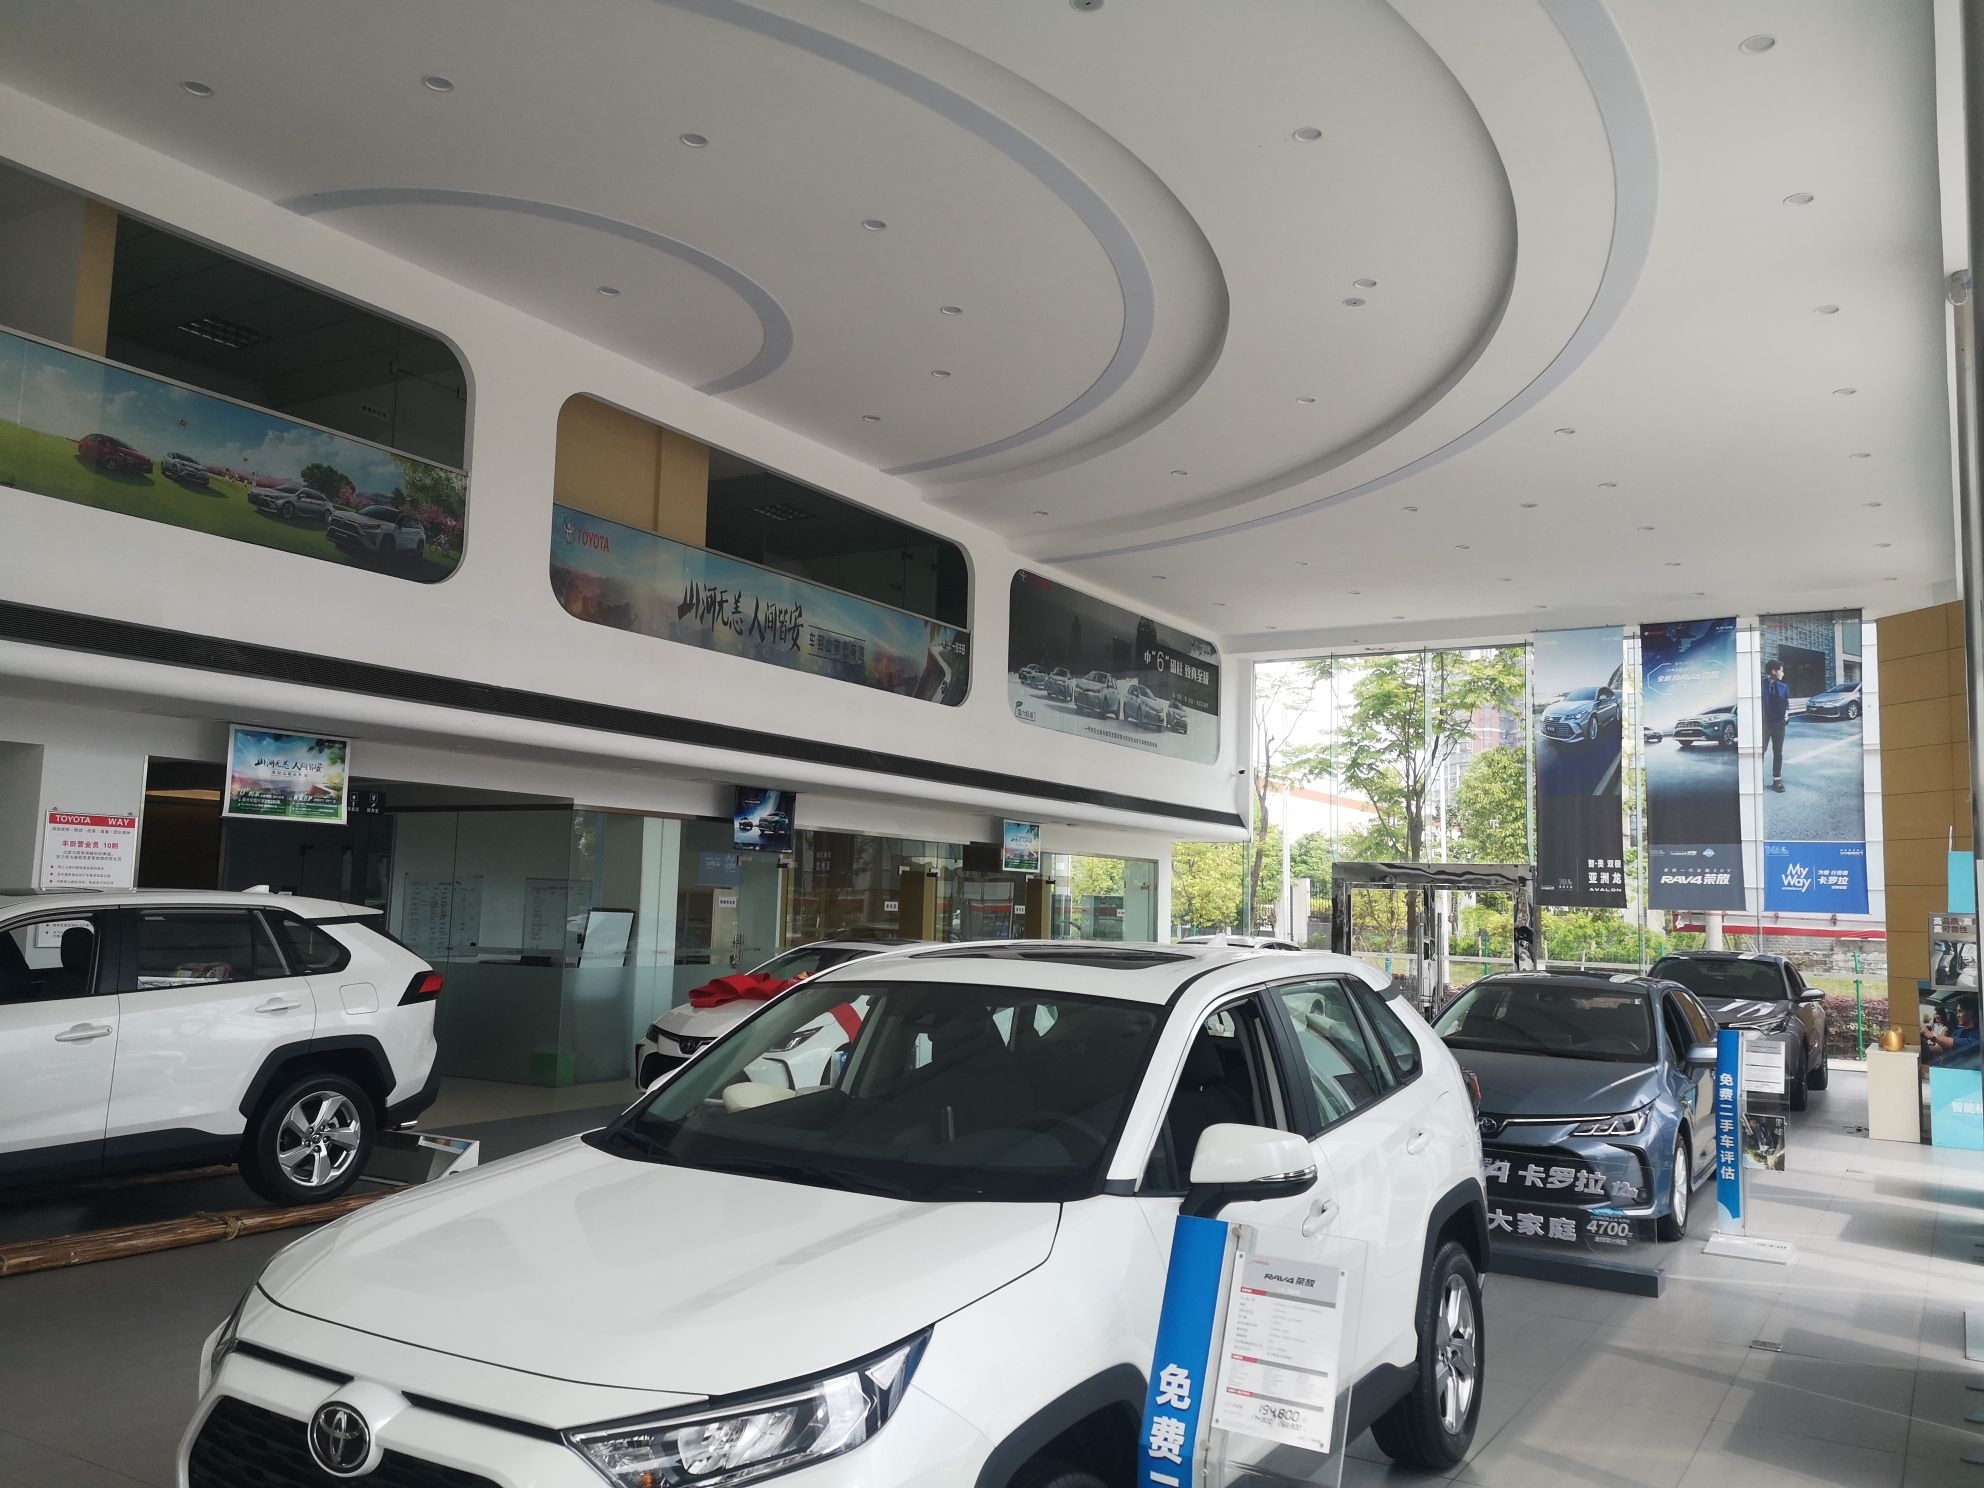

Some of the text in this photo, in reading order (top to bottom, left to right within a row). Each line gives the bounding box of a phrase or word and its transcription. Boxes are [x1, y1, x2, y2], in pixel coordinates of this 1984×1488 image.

[577, 527, 610, 553] TOYOTA
[55, 814, 130, 826] TOYOTA WAY
[1588, 872, 1622, 885] 亚洲龙
[1786, 863, 1810, 879] My
[1781, 874, 1812, 893] Way
[1817, 876, 1849, 885] 卡罗拉
[1718, 1073, 1736, 1182] 免费二手车评估
[1517, 1164, 1607, 1195] 卡罗拉
